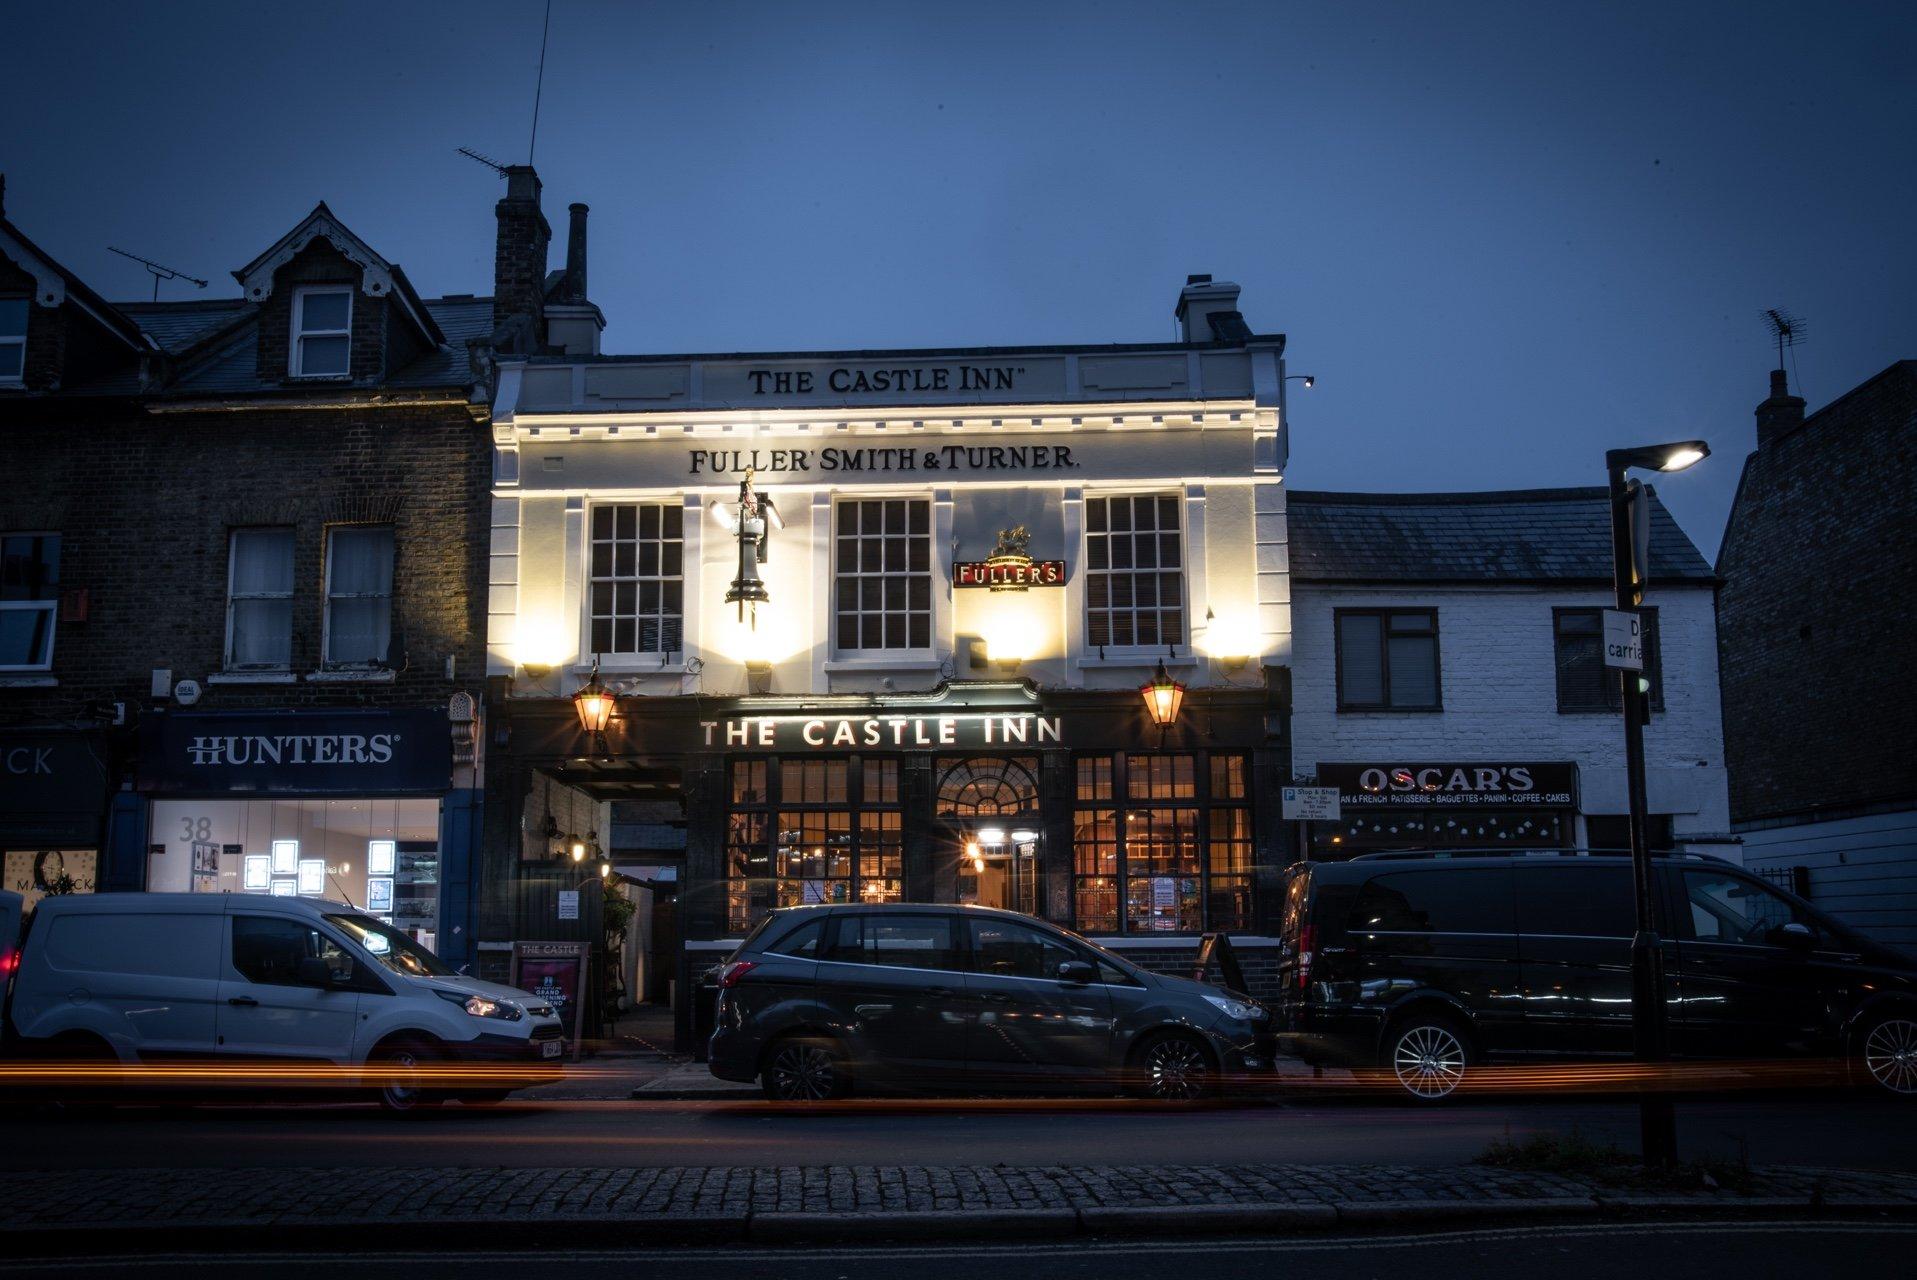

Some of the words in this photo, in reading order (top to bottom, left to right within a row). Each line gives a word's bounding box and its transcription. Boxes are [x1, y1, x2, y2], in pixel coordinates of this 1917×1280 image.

[749, 369, 814, 393] THE
[828, 368, 950, 393] CASTLE
[820, 447, 917, 470] SMITH
[923, 452, 940, 469] &
[960, 565, 1057, 584] FULLER'S
[700, 720, 775, 746] THE
[803, 719, 955, 745] CASTLE
[985, 717, 1061, 743] INN
[0, 747, 53, 775] CK
[1359, 767, 1534, 791] OSCAR'S
[1359, 794, 1388, 804] FRENCH
[1391, 794, 1431, 803] PATISSERIE
[1436, 794, 1479, 803] BAGUETTES
[1484, 794, 1507, 803] PANINI
[1512, 793, 1541, 803] COFFEE
[1545, 793, 1570, 803] CAKES
[180, 816, 212, 842] 38
[521, 945, 540, 954] THE
[543, 945, 579, 954] CASTLE
